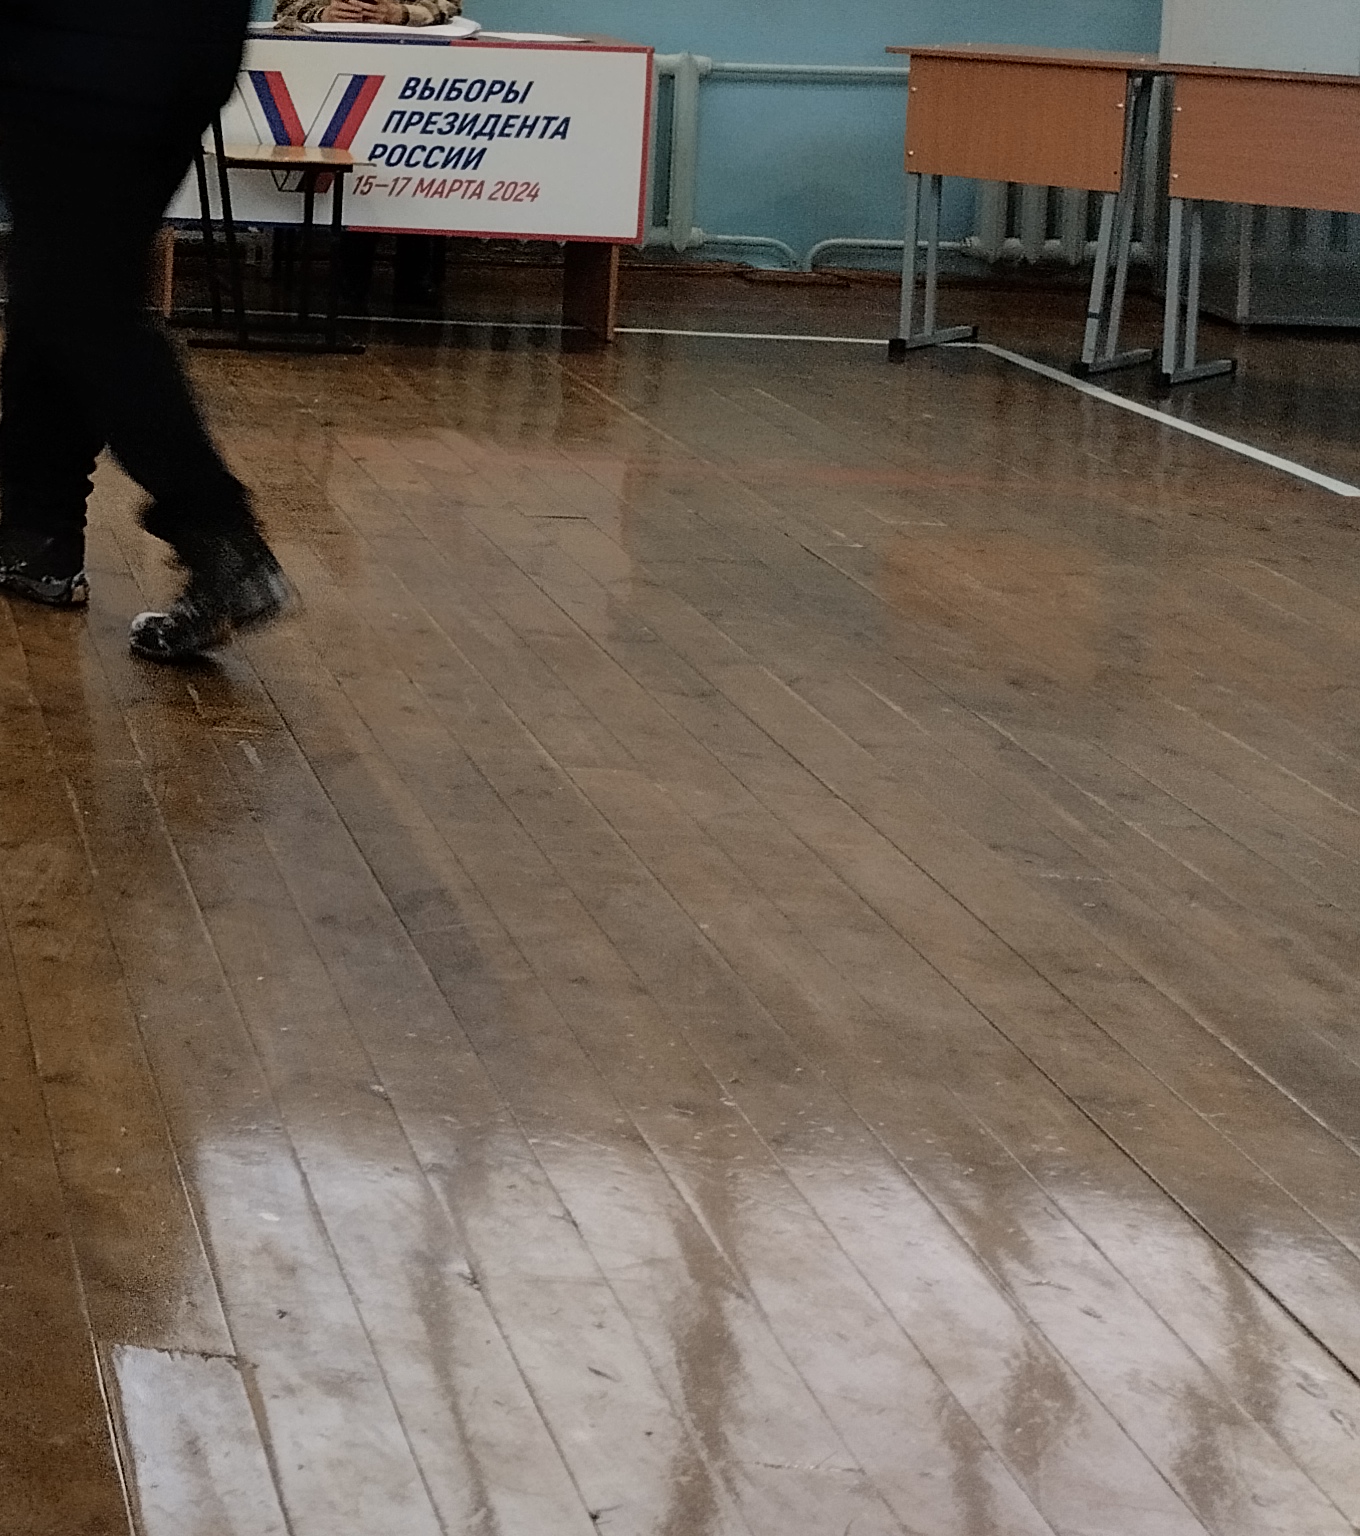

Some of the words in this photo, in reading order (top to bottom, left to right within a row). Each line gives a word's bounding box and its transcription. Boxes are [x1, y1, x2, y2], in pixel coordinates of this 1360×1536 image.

[398, 76, 534, 105] ВЫБОРЫ
[381, 109, 572, 141] ПРЕЗИДЕНТА
[368, 143, 487, 171] РОССИИ
[411, 177, 484, 201] МАРТА
[487, 180, 541, 203] 2024
